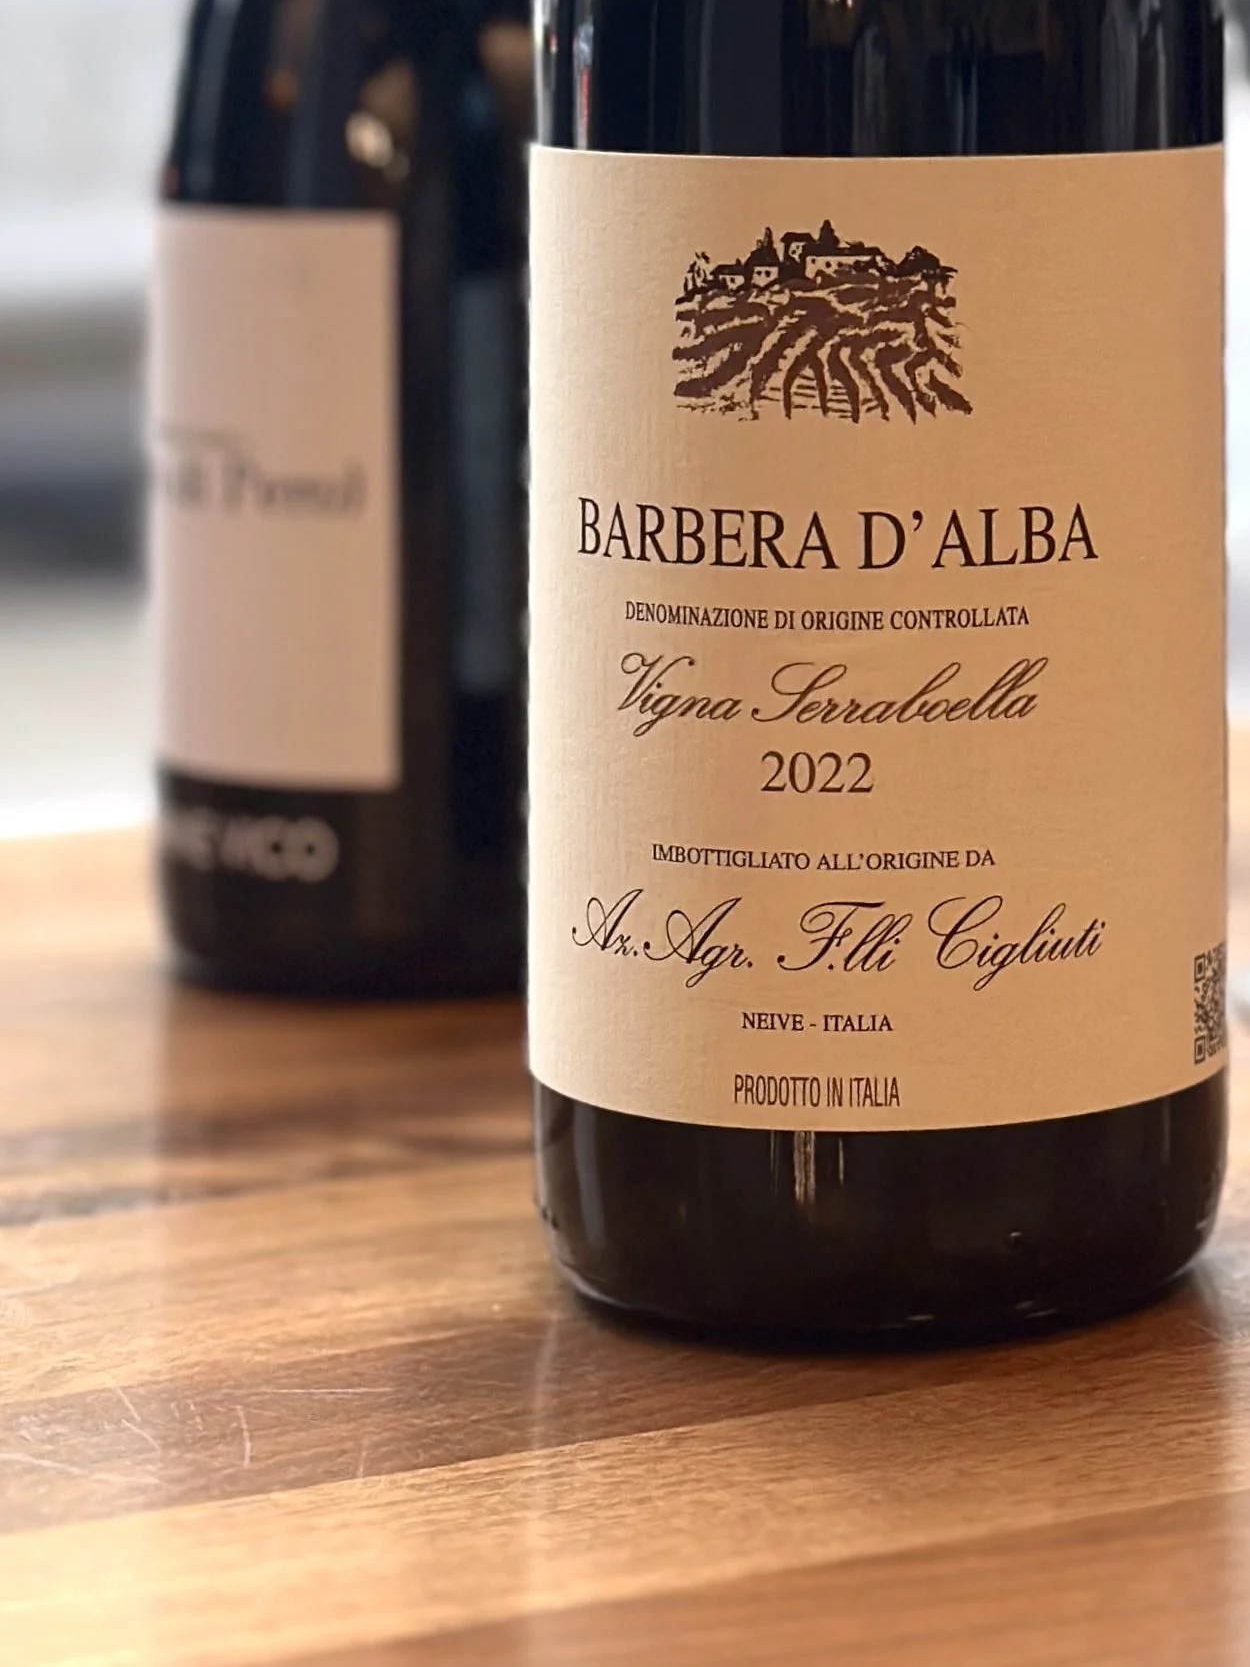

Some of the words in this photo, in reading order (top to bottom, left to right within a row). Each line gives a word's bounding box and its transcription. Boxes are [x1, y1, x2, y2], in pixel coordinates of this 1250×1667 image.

[577, 496, 840, 570] BARBERA
[625, 600, 768, 630] DENOMINAZIONE
[774, 609, 796, 631] DI
[801, 609, 885, 631] ORIGINE
[890, 605, 1030, 630] CONTROLLATA
[617, 652, 743, 737] Vigna
[751, 656, 1050, 725] Serraboella
[760, 750, 874, 794] 2022
[651, 843, 811, 871] IMBOTTIGLIATO
[965, 849, 996, 869] DA
[927, 894, 1106, 992] Cigliuti
[741, 1011, 804, 1032] NEIVE
[823, 1013, 894, 1033] ITALIA
[734, 1073, 821, 1108] PRODOTTO
[826, 1076, 843, 1107] IN
[849, 1076, 901, 1109] ITALIA
